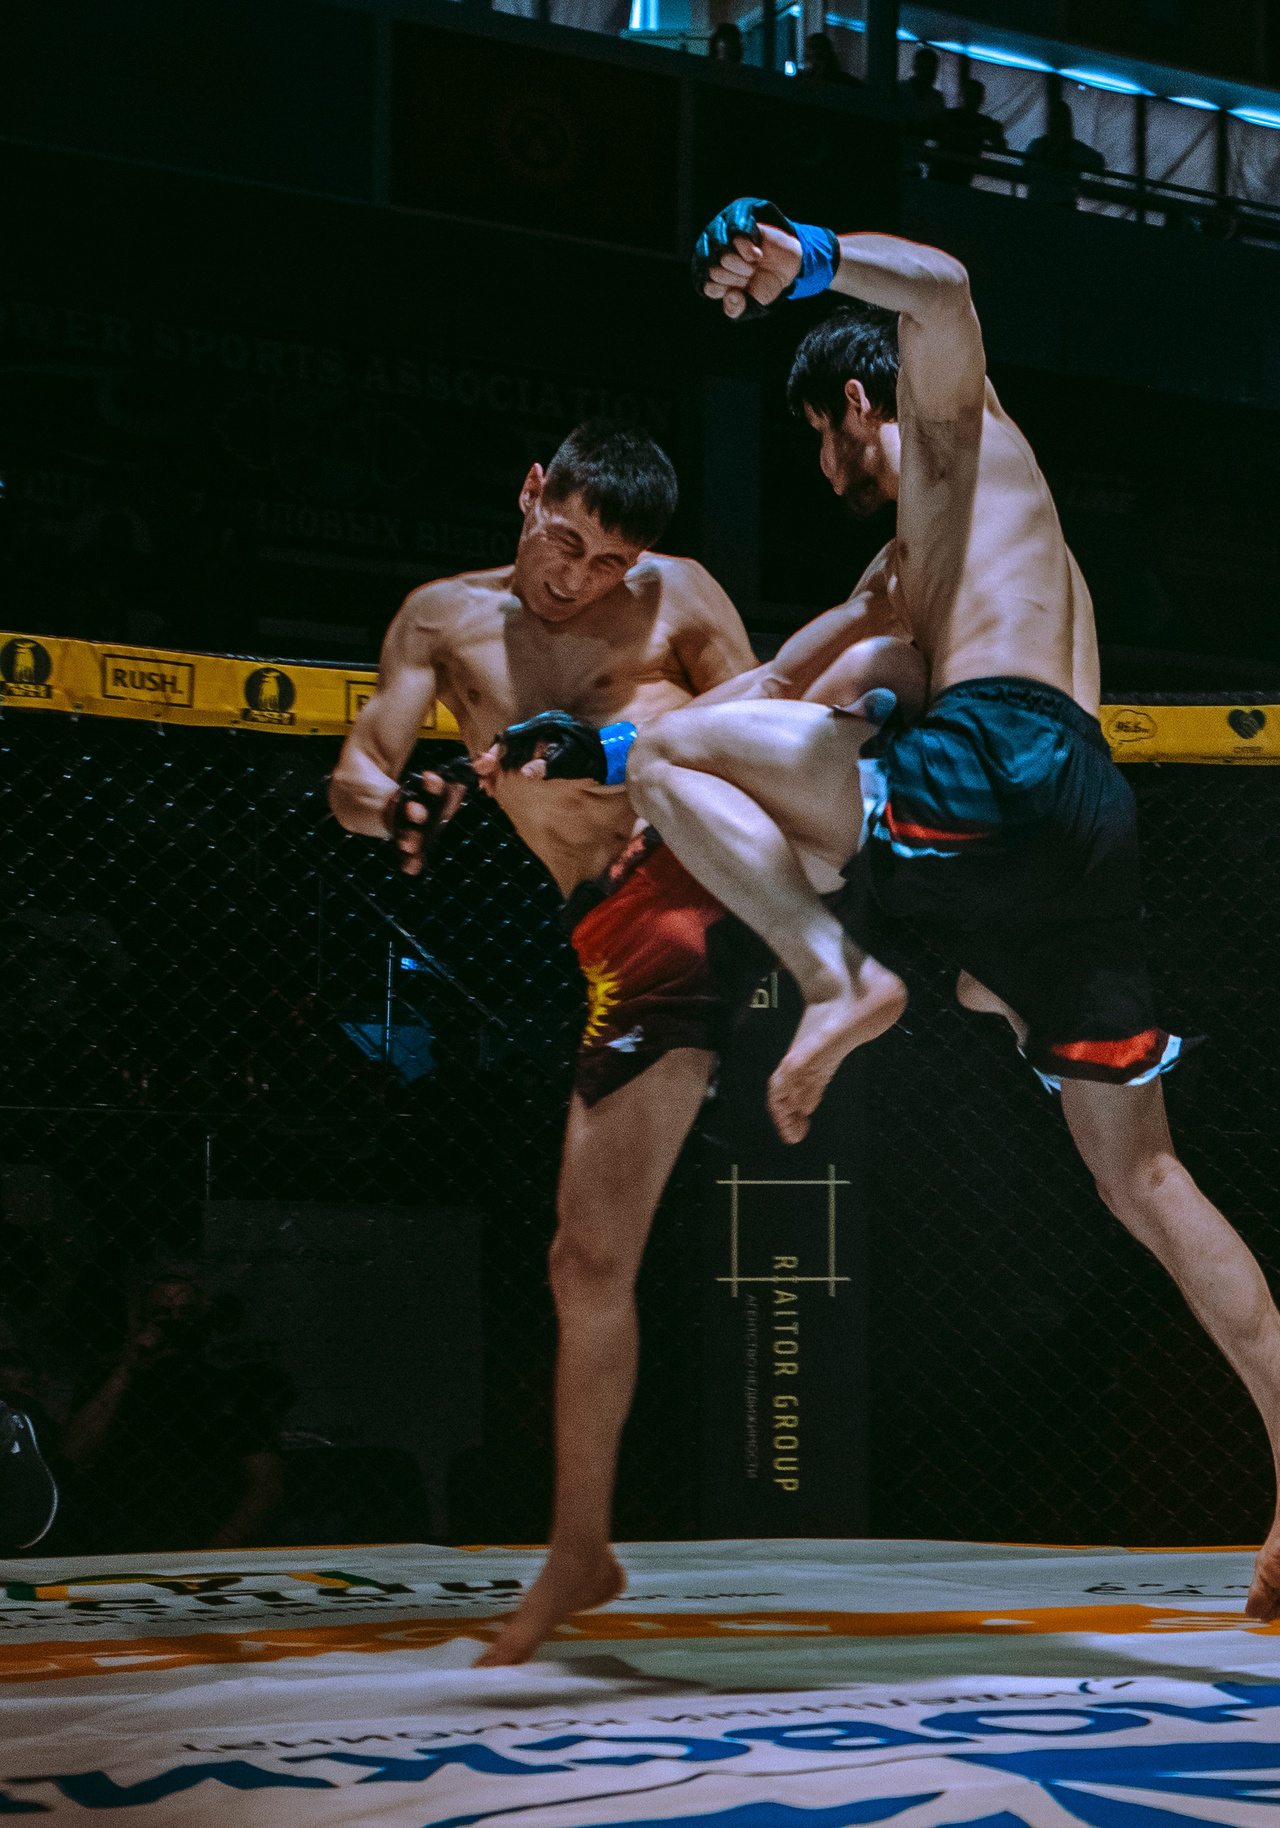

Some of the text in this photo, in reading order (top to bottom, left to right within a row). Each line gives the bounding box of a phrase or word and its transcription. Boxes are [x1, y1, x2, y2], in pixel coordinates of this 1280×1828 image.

[0, 301, 674, 433] WER SPORTS ASSOCIATION
[416, 520, 514, 562] ВИДО
[771, 1394, 800, 1493] GROUP
